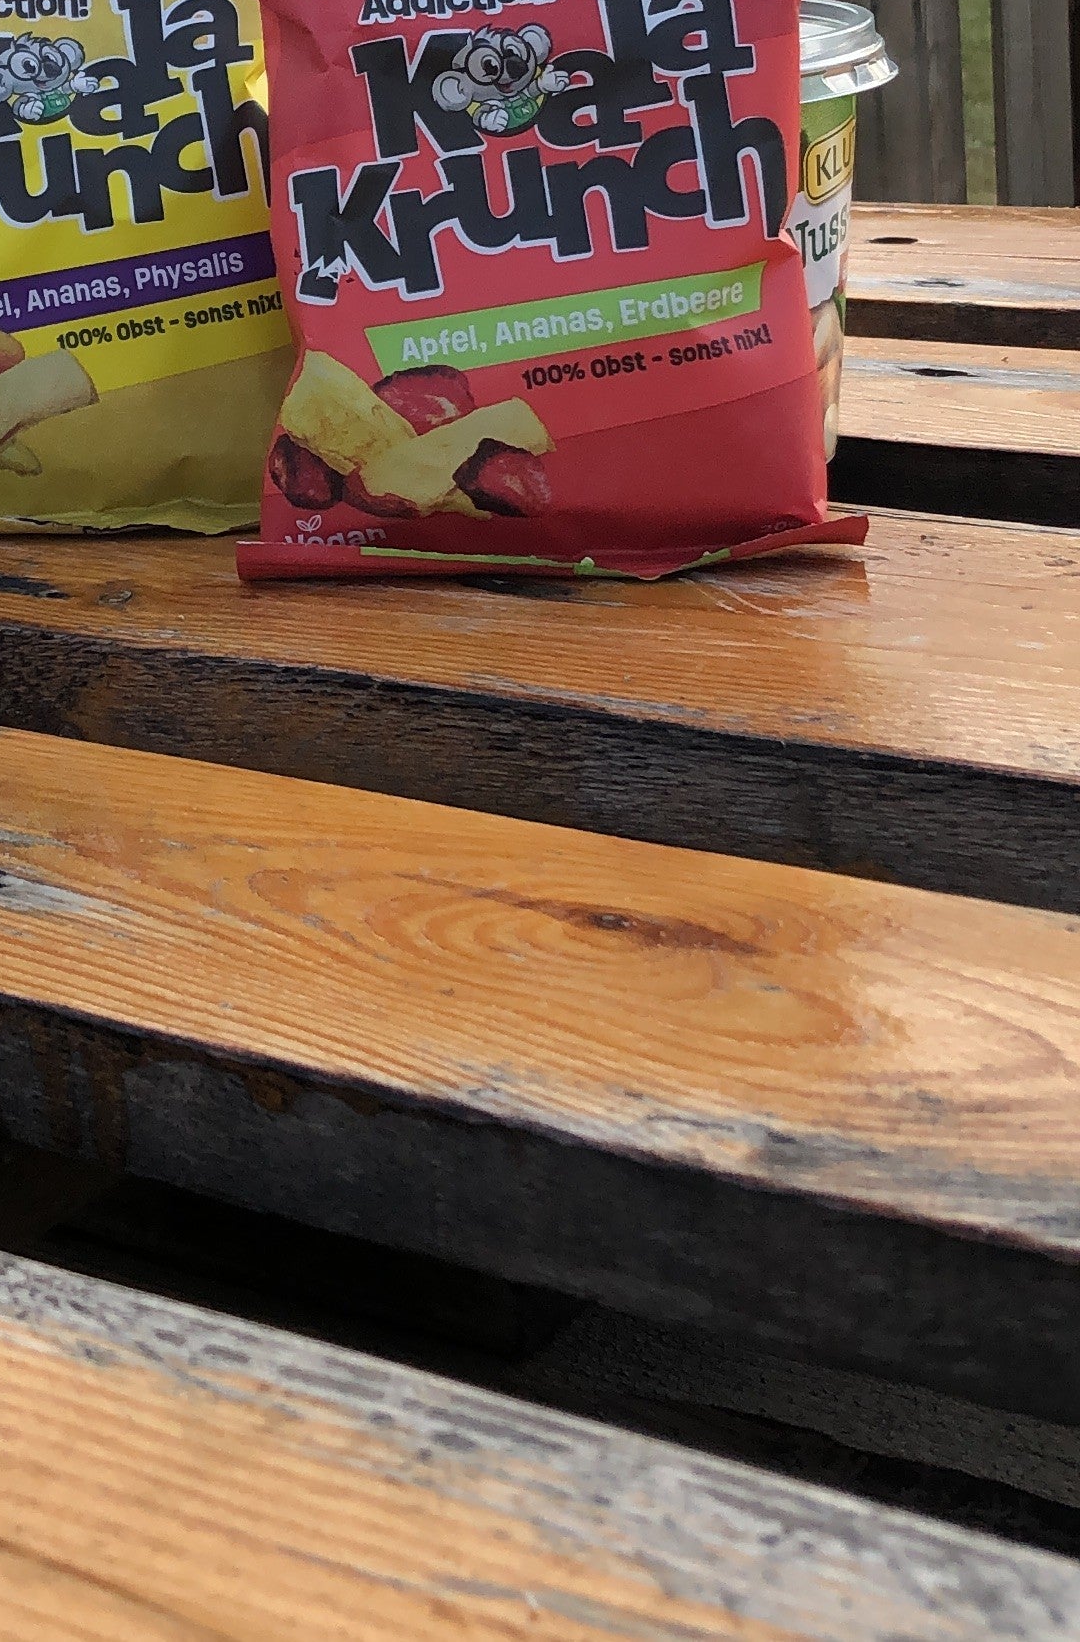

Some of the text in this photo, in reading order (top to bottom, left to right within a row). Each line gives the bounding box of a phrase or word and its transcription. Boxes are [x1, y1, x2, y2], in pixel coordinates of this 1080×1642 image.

[287, 68, 788, 305] Krunch
[27, 277, 131, 313] Ananas,
[134, 251, 245, 292] Physalis
[56, 326, 112, 349] 100%
[116, 316, 166, 340] Obst
[183, 300, 243, 328] sonst
[248, 291, 283, 316] nix!
[402, 279, 745, 363] Apfel, Ananas, Erdbeere
[522, 361, 586, 390] 100%
[590, 349, 647, 379] Obst
[669, 332, 733, 366] sonst
[735, 323, 773, 350] nix!
